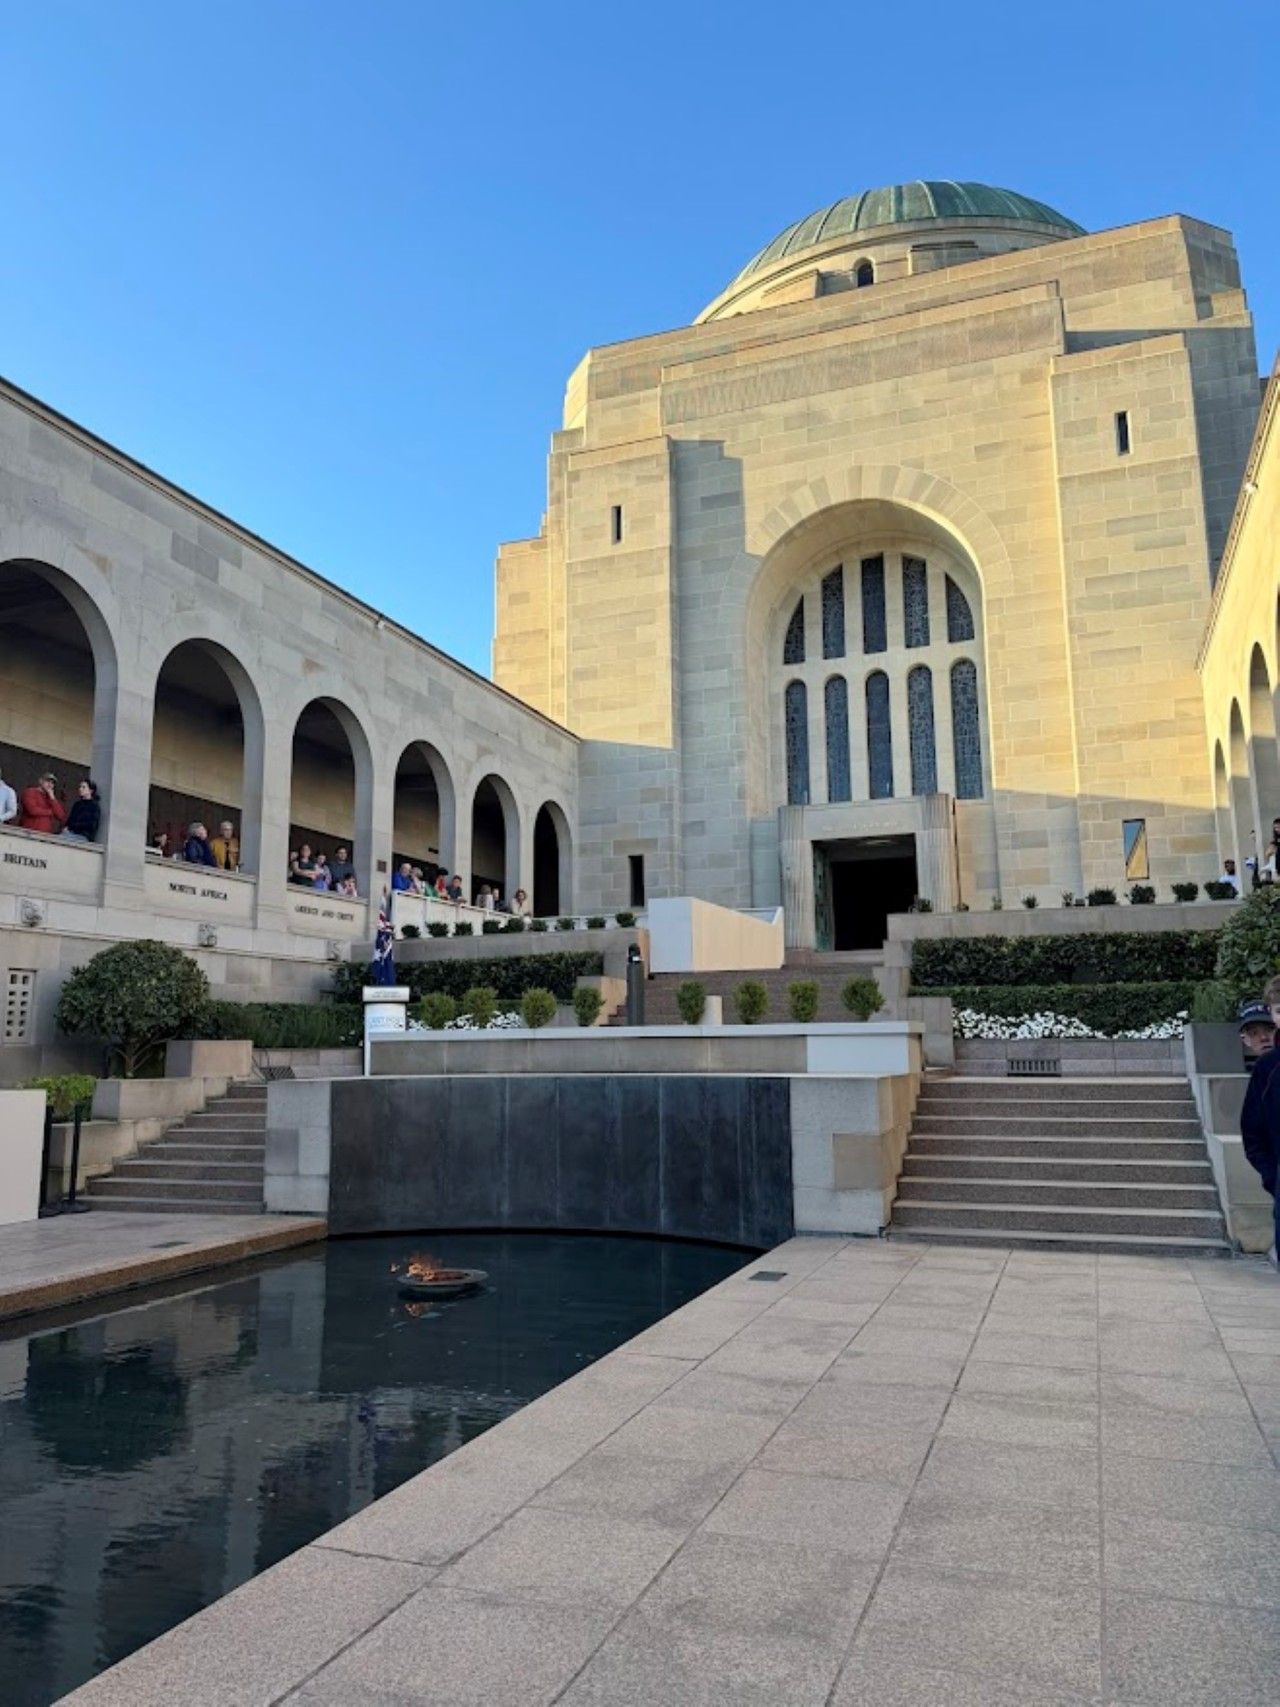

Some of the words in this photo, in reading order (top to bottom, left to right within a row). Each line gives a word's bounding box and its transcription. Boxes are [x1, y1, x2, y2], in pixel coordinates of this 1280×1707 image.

[4, 853, 47, 868] BRITAIN
[168, 882, 196, 895] NORTH
[201, 888, 228, 901] AFRICA
